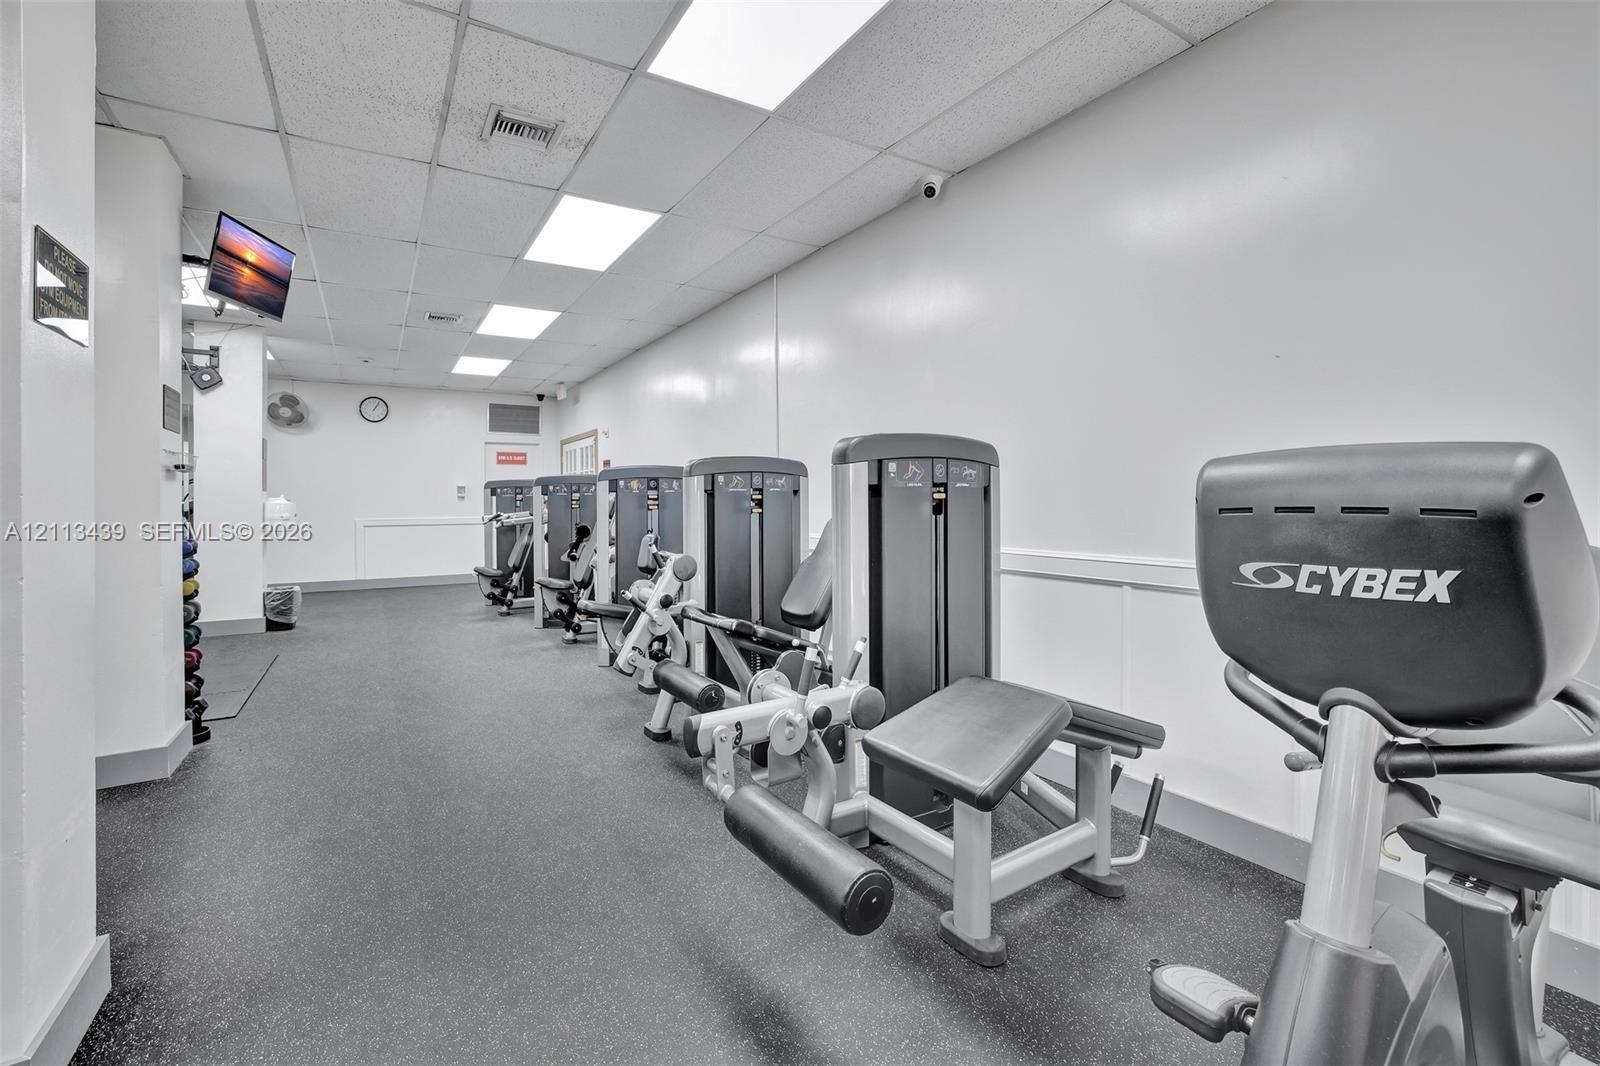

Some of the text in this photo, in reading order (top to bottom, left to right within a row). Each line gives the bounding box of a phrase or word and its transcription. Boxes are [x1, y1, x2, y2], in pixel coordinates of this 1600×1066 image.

[53, 245, 76, 275] PLEASE
[68, 276, 84, 299] MOVE
[40, 298, 58, 318] FROM
[55, 287, 87, 319] EQUIPMENT
[1295, 563, 1464, 604] CYBEX
